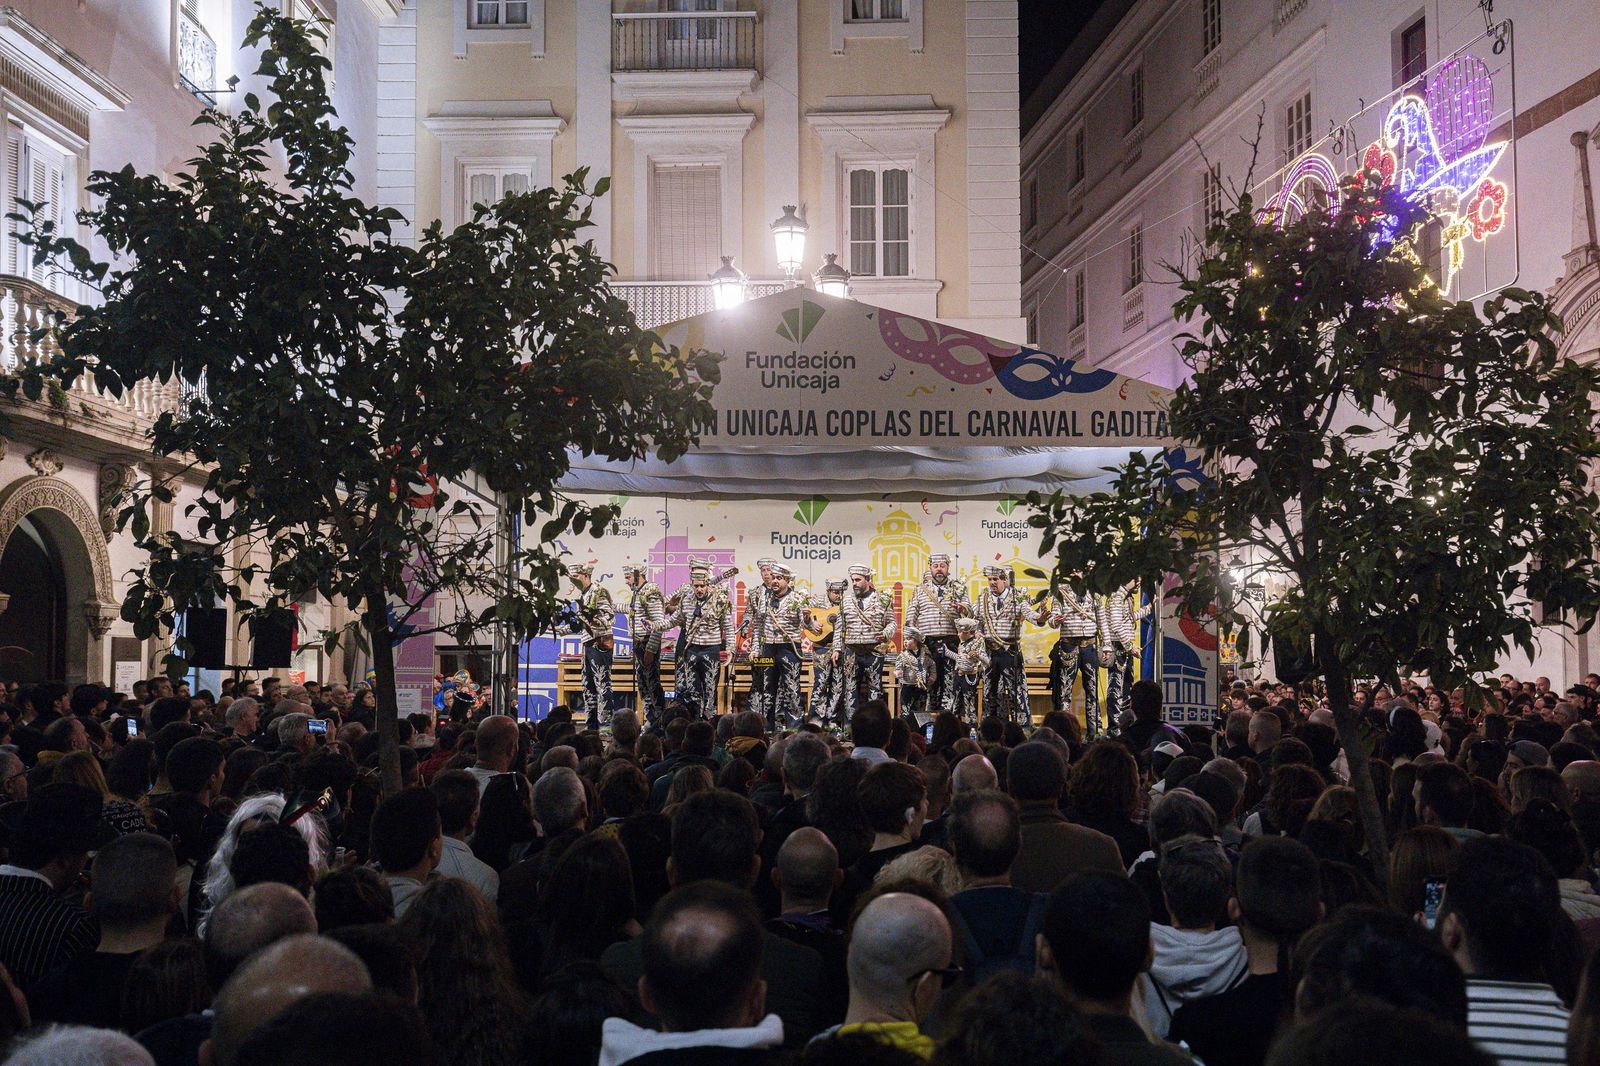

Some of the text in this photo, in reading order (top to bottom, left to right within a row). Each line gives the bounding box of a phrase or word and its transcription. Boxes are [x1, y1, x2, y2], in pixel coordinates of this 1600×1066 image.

[745, 351, 856, 370] Fundación
[761, 370, 840, 394] Unicaja
[726, 409, 818, 437] UNICAJA
[826, 409, 911, 437] COPLAS
[919, 410, 960, 437] DEL
[967, 410, 1083, 437] CARNAVAL
[1091, 410, 1174, 437] GADITA
[981, 519, 1033, 529] Fundació
[770, 531, 853, 545] Fundación
[988, 529, 1028, 541] Unicaja
[782, 545, 841, 563] Unicaja
